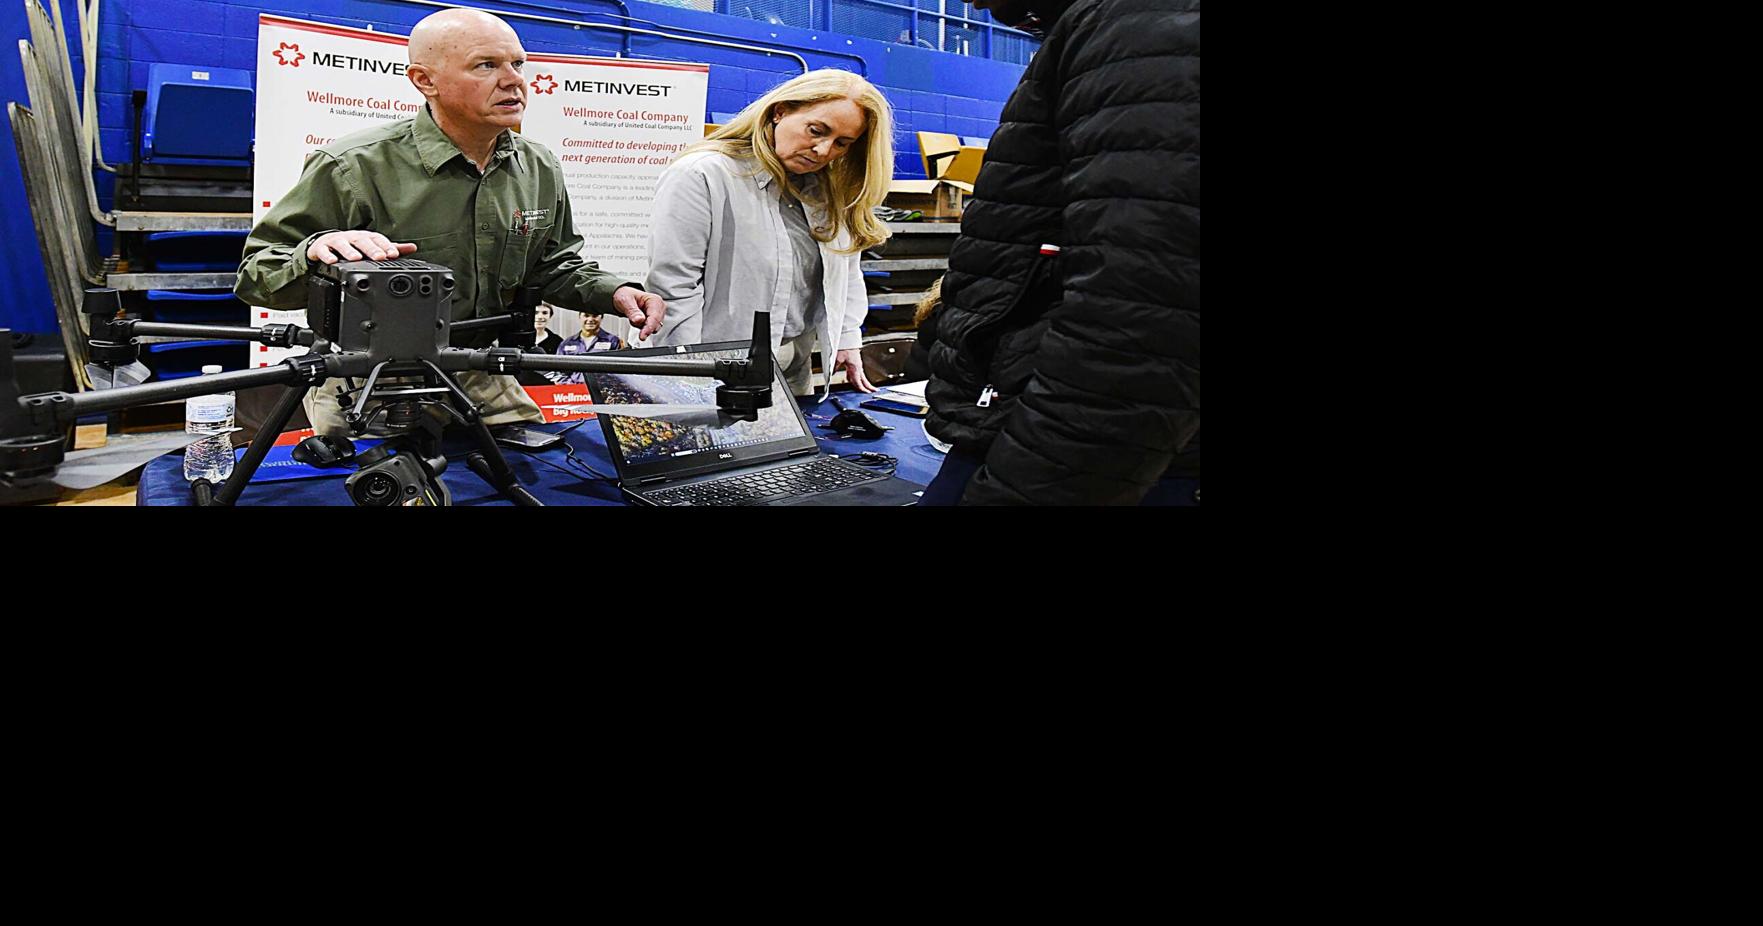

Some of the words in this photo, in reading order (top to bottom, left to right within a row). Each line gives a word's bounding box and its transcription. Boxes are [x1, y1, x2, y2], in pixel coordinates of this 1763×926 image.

[564, 80, 672, 97] METINVEST
[307, 90, 364, 107] Wellmore
[366, 97, 391, 110] Coal
[335, 107, 367, 119] subsidiary
[367, 111, 375, 119] of
[375, 112, 397, 120] United
[563, 106, 614, 119] Wellmore
[616, 109, 638, 120] Coal
[641, 110, 689, 124] Company
[588, 120, 617, 128] subsidiary
[657, 123, 683, 131] Company
[305, 134, 324, 145] Our
[562, 137, 614, 149] Committed
[615, 140, 625, 150] to
[626, 140, 678, 154] developing
[562, 154, 583, 162] next
[585, 155, 637, 165] generation
[637, 155, 649, 165] of
[649, 156, 669, 165] coal
